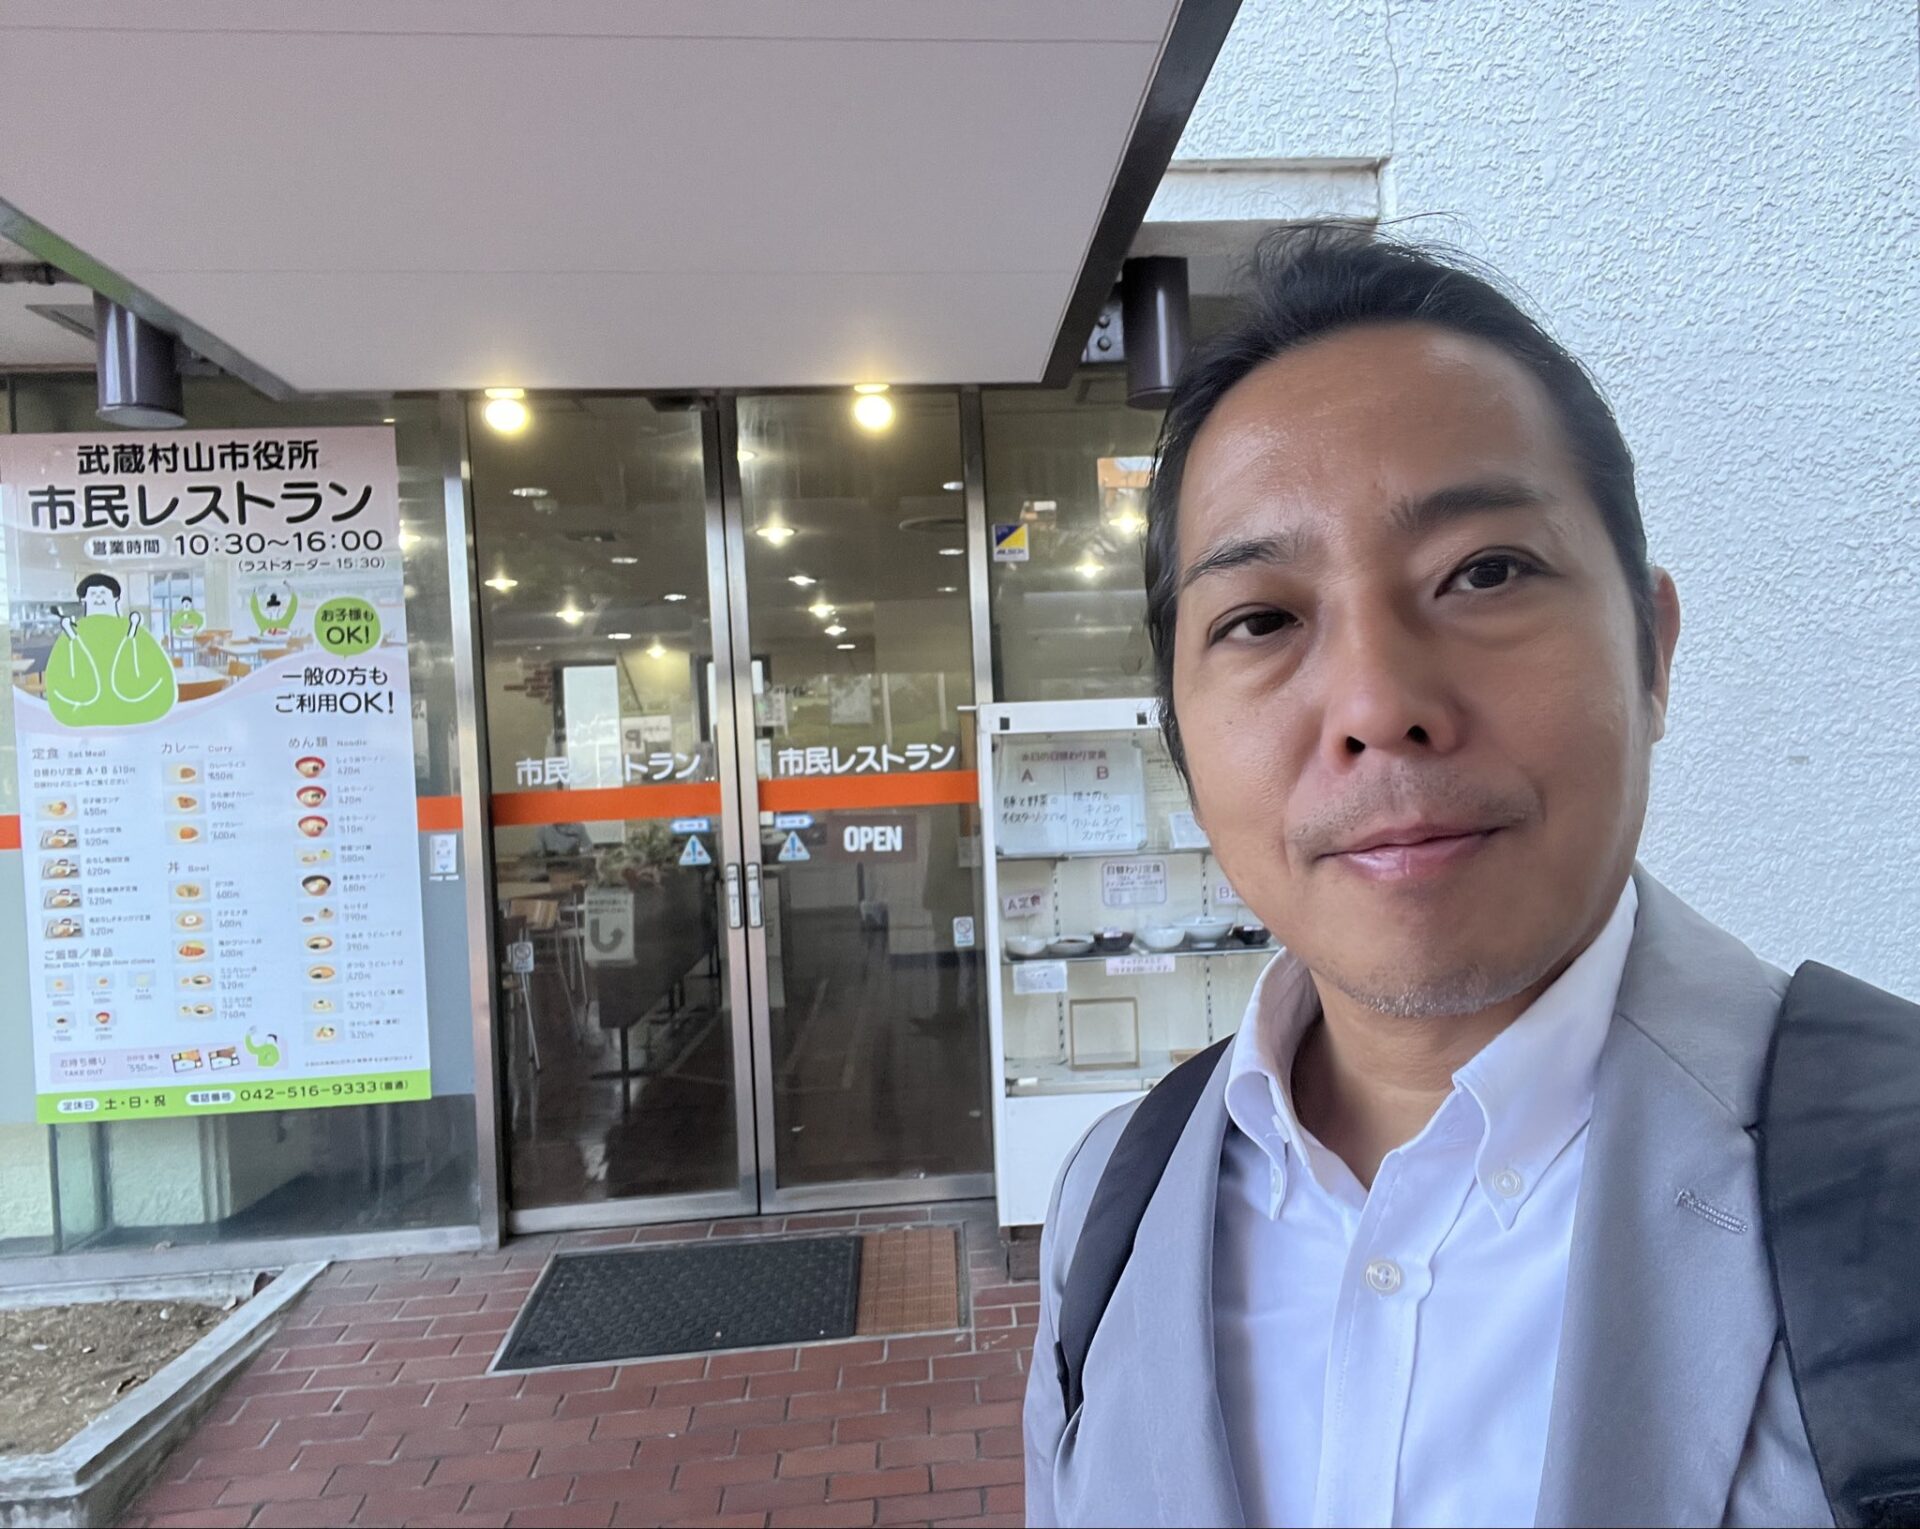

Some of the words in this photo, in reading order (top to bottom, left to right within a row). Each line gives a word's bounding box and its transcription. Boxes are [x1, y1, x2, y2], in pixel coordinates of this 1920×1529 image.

[77, 439, 320, 475] 武蔵村山市役所
[29, 481, 373, 531] 市民レストラン
[92, 539, 161, 556] 営業時間
[321, 607, 375, 624] お子様も
[326, 626, 371, 646] OK!
[282, 667, 389, 688] 一般の方も
[276, 690, 395, 715] ご利用OK!
[161, 742, 199, 754] カレー
[208, 744, 233, 753] Curry
[288, 736, 328, 749] めん類
[32, 748, 59, 760] 定食
[778, 744, 956, 777] 市民レストラン
[1021, 768, 1034, 783] A
[1096, 766, 1110, 780] B
[843, 825, 903, 853] OPEN
[104, 1094, 166, 1111] 土・日・祝
[190, 1091, 232, 1104] 電話番号
